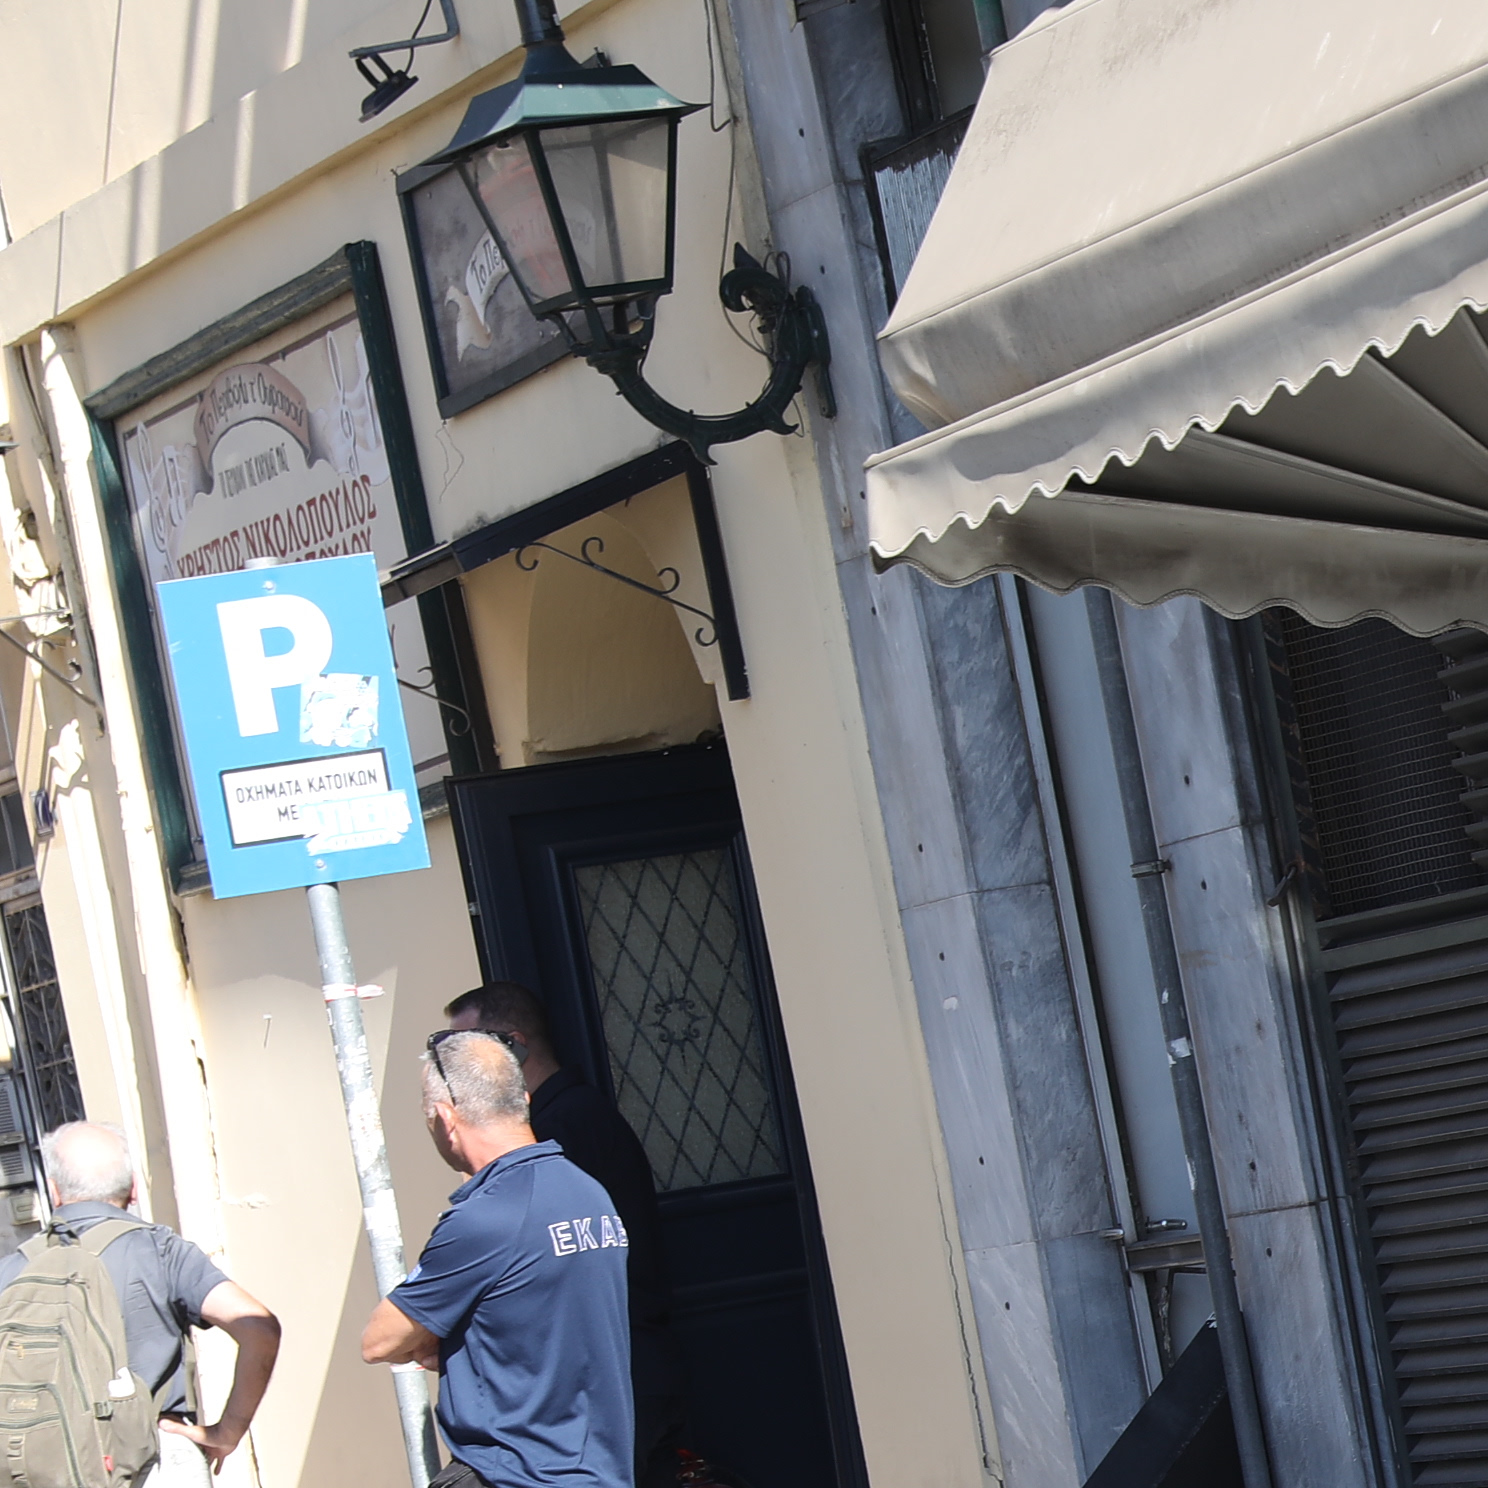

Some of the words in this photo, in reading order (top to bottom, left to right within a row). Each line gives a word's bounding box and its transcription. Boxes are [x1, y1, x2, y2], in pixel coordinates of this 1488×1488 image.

[242, 474, 377, 558] ΝΙΚΟΛΟΠΟΥΛΟΣ
[216, 594, 333, 738] P
[236, 780, 303, 804] ΟΧΗΜΑΤΑ
[307, 769, 378, 793] ΚΑΤΟΙΚΩΝ
[277, 804, 299, 822] ΜΕ
